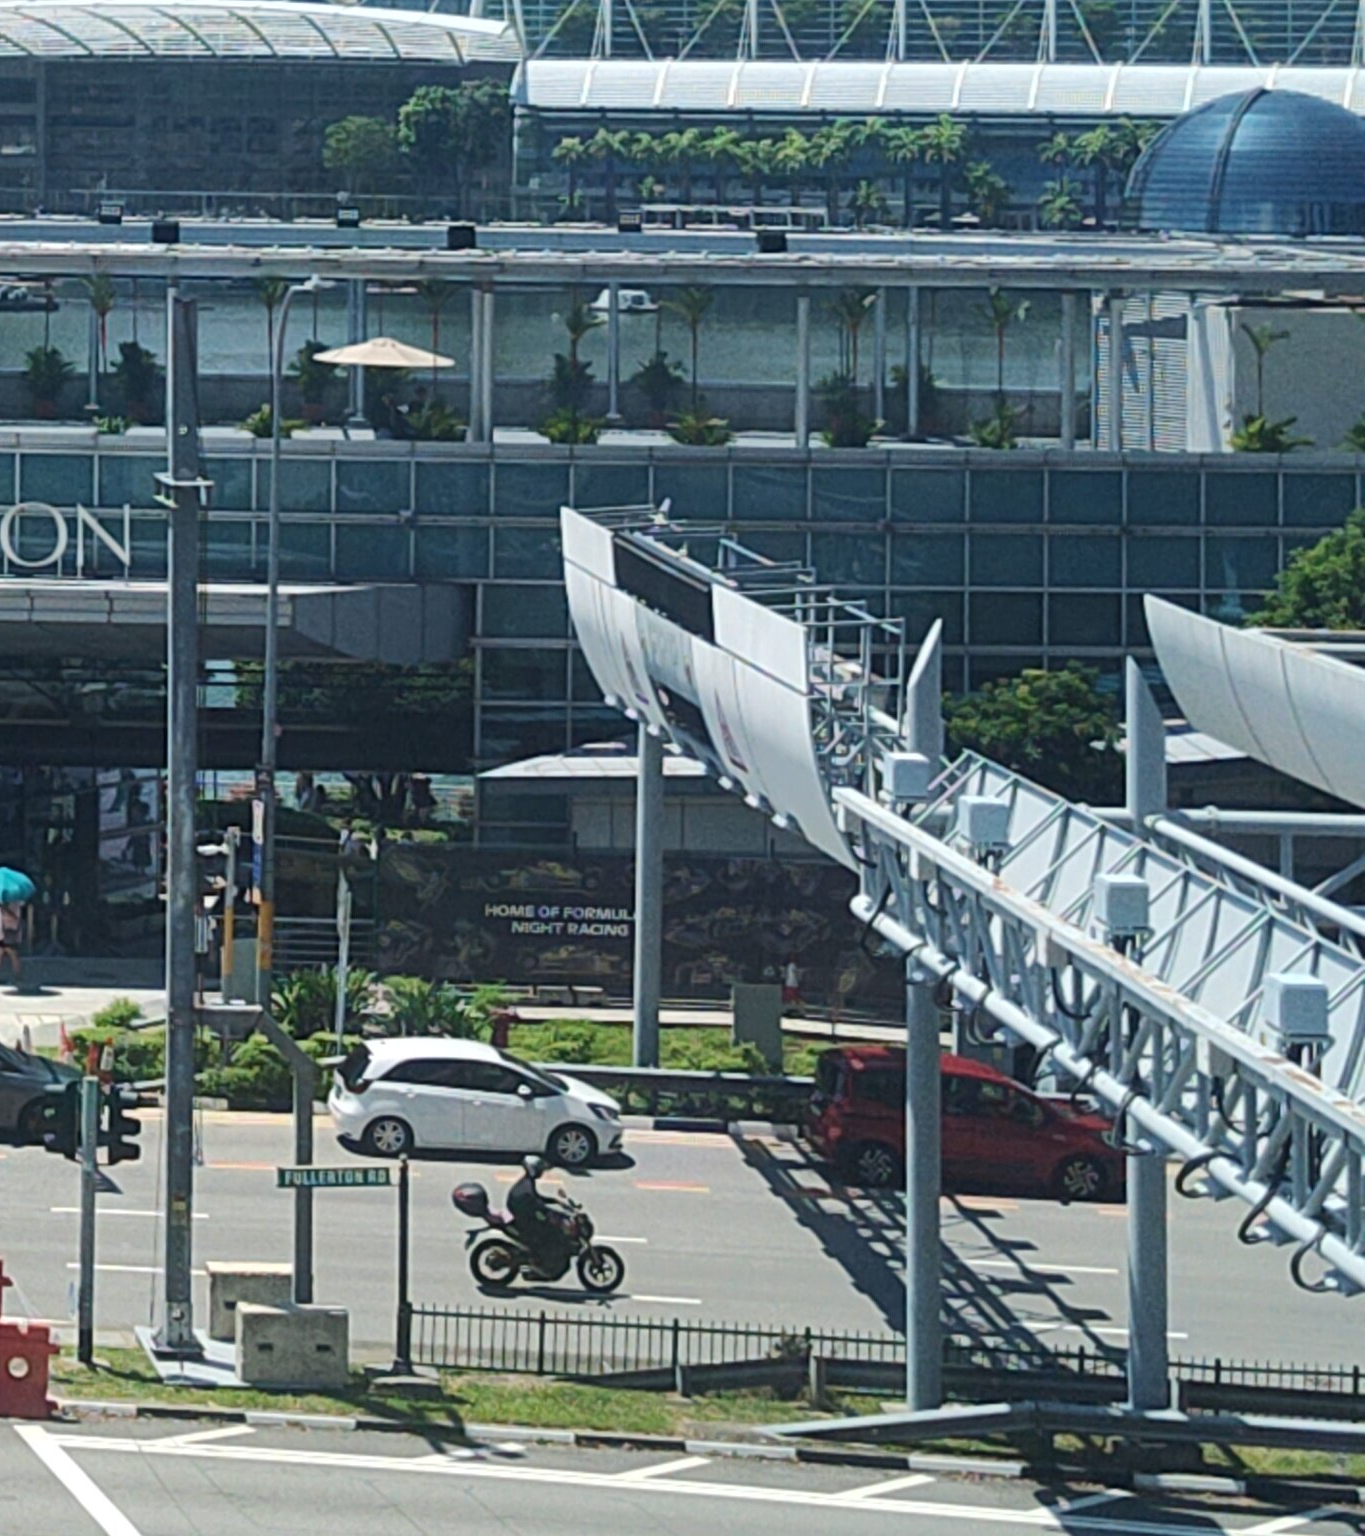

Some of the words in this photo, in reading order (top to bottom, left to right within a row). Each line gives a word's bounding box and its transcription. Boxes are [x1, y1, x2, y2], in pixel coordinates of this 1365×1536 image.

[484, 903, 535, 917] HOME
[537, 905, 559, 918] OF
[563, 907, 636, 920] FORMUL
[511, 921, 563, 935] NIGHT
[567, 923, 630, 937] RACING
[285, 1169, 363, 1185] FULLERTON
[368, 1168, 386, 1183] RD
